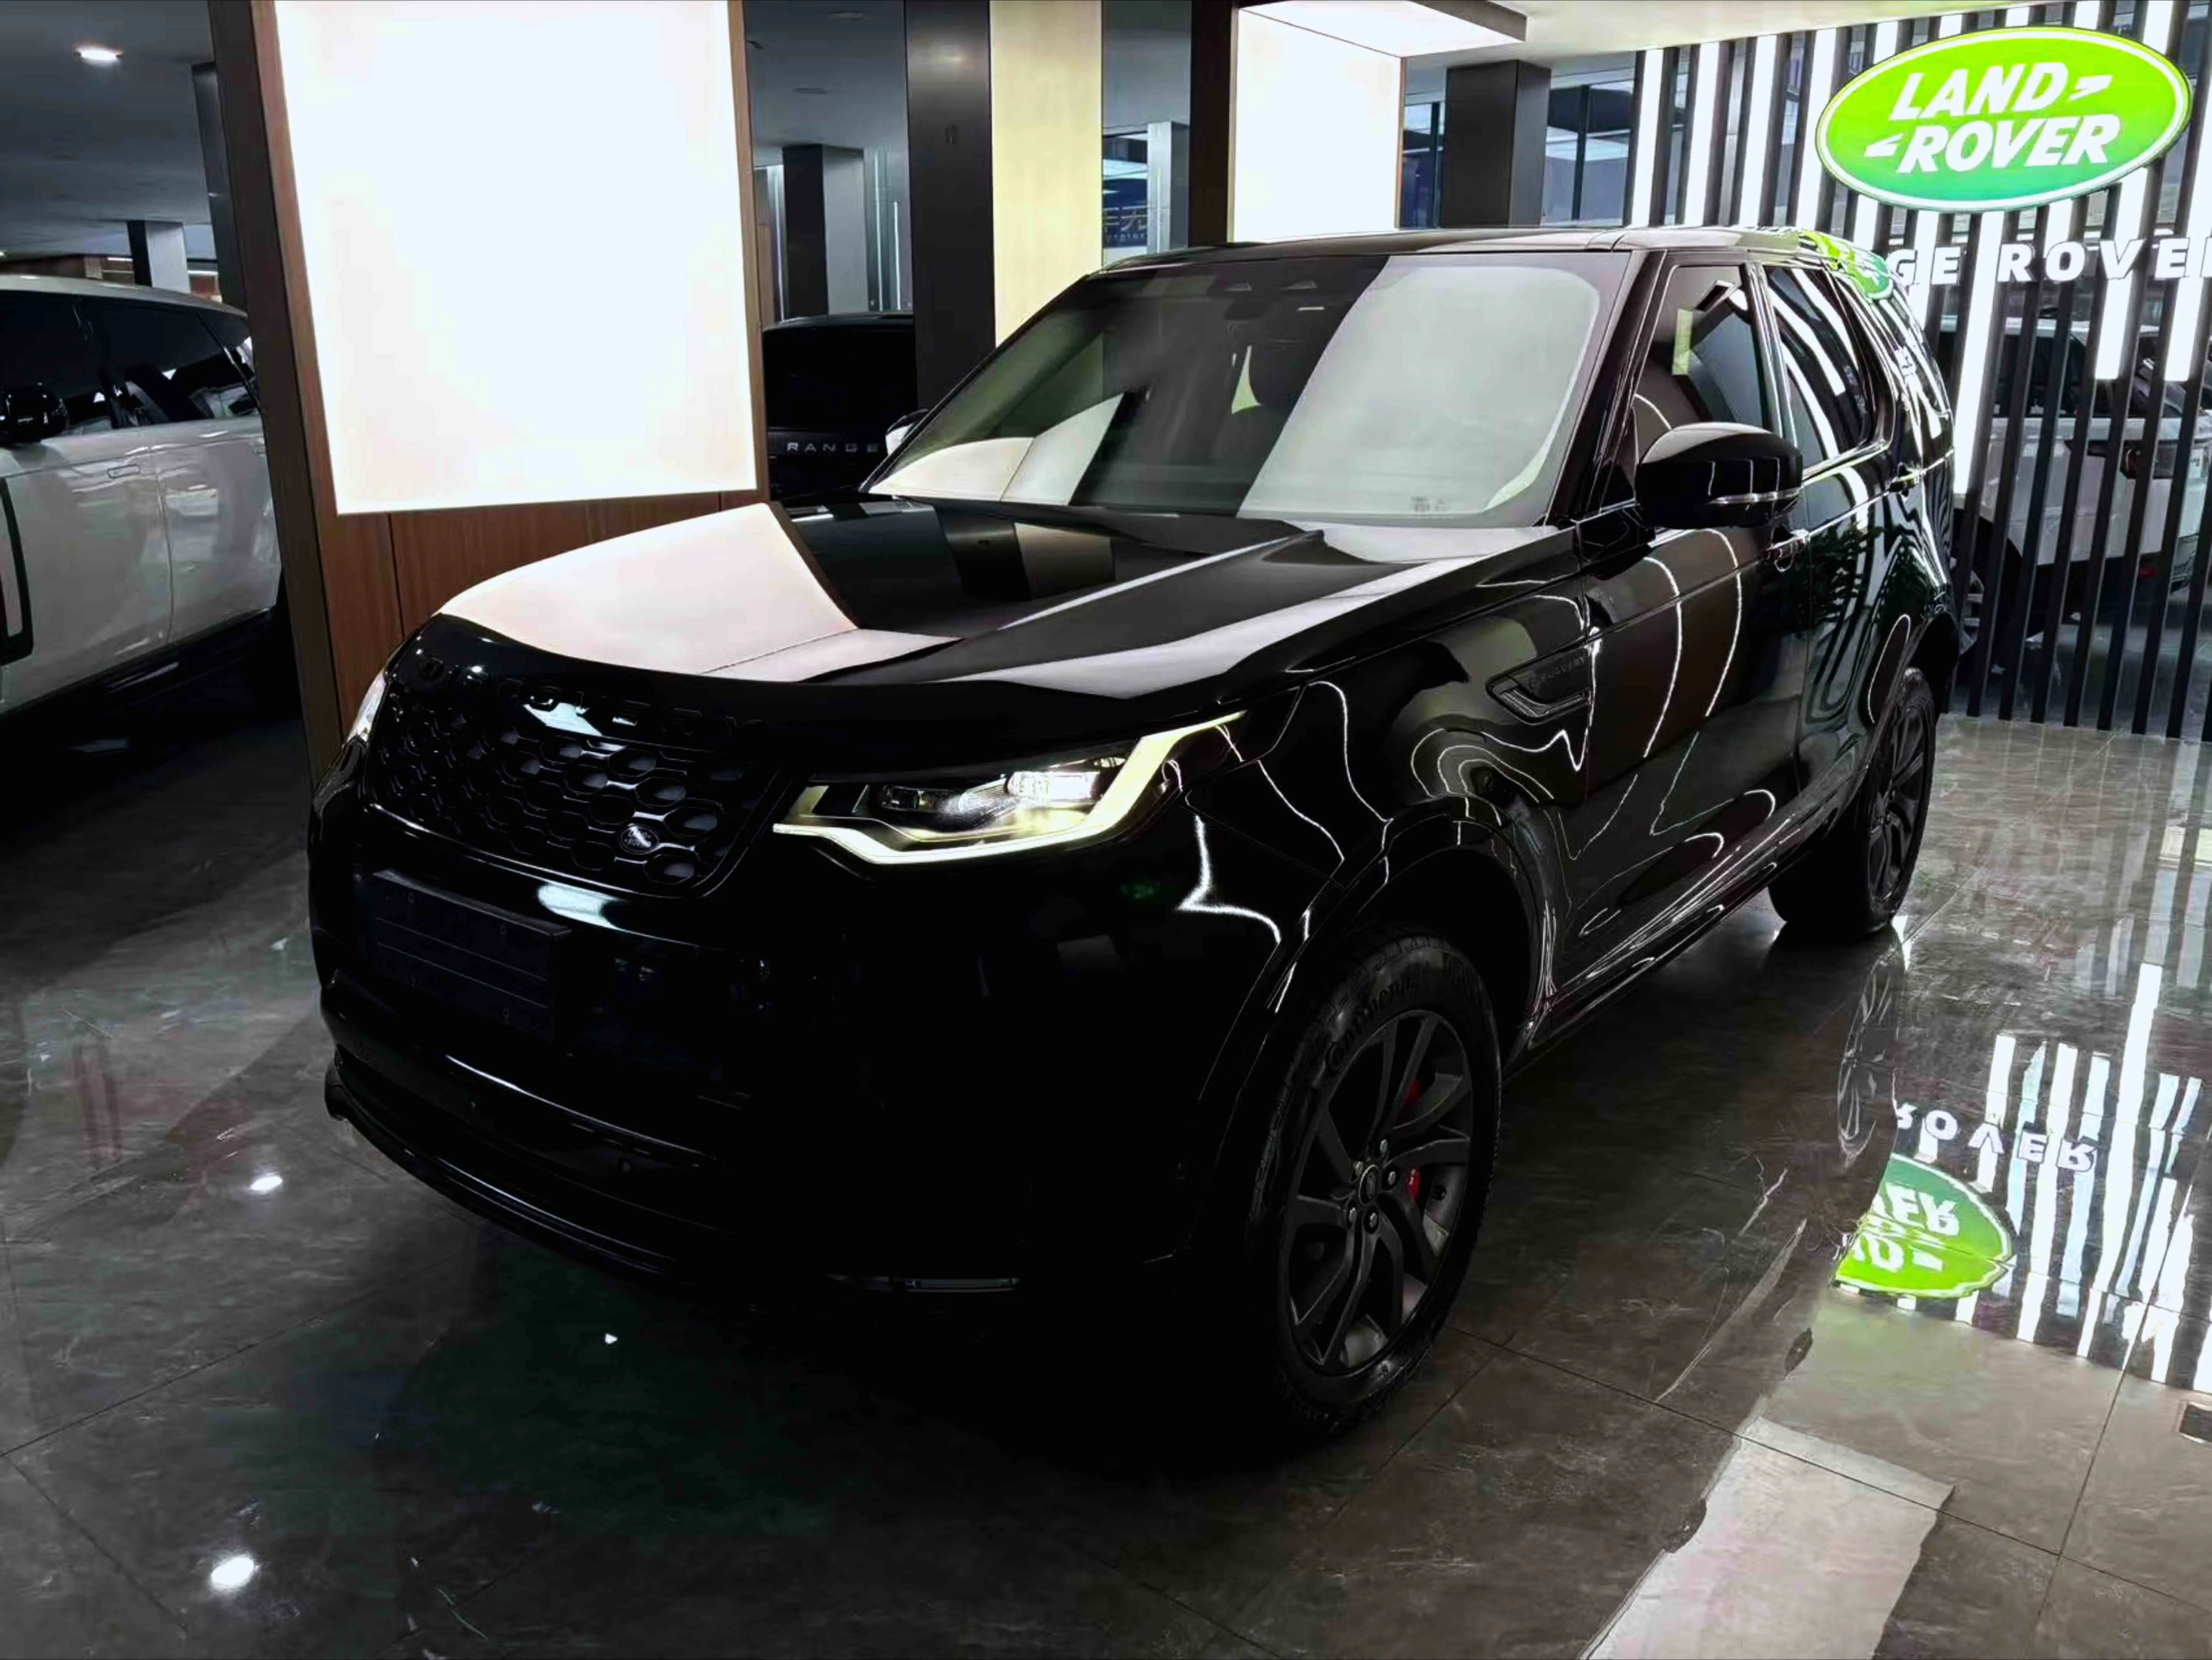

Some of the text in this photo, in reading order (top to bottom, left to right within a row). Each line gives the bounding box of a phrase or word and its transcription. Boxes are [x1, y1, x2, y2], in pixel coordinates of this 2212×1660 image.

[1890, 62, 2068, 121] LAND
[1896, 114, 2121, 174] ROVER
[1998, 238, 2212, 282] ROVE
[787, 442, 879, 453] RANGE
